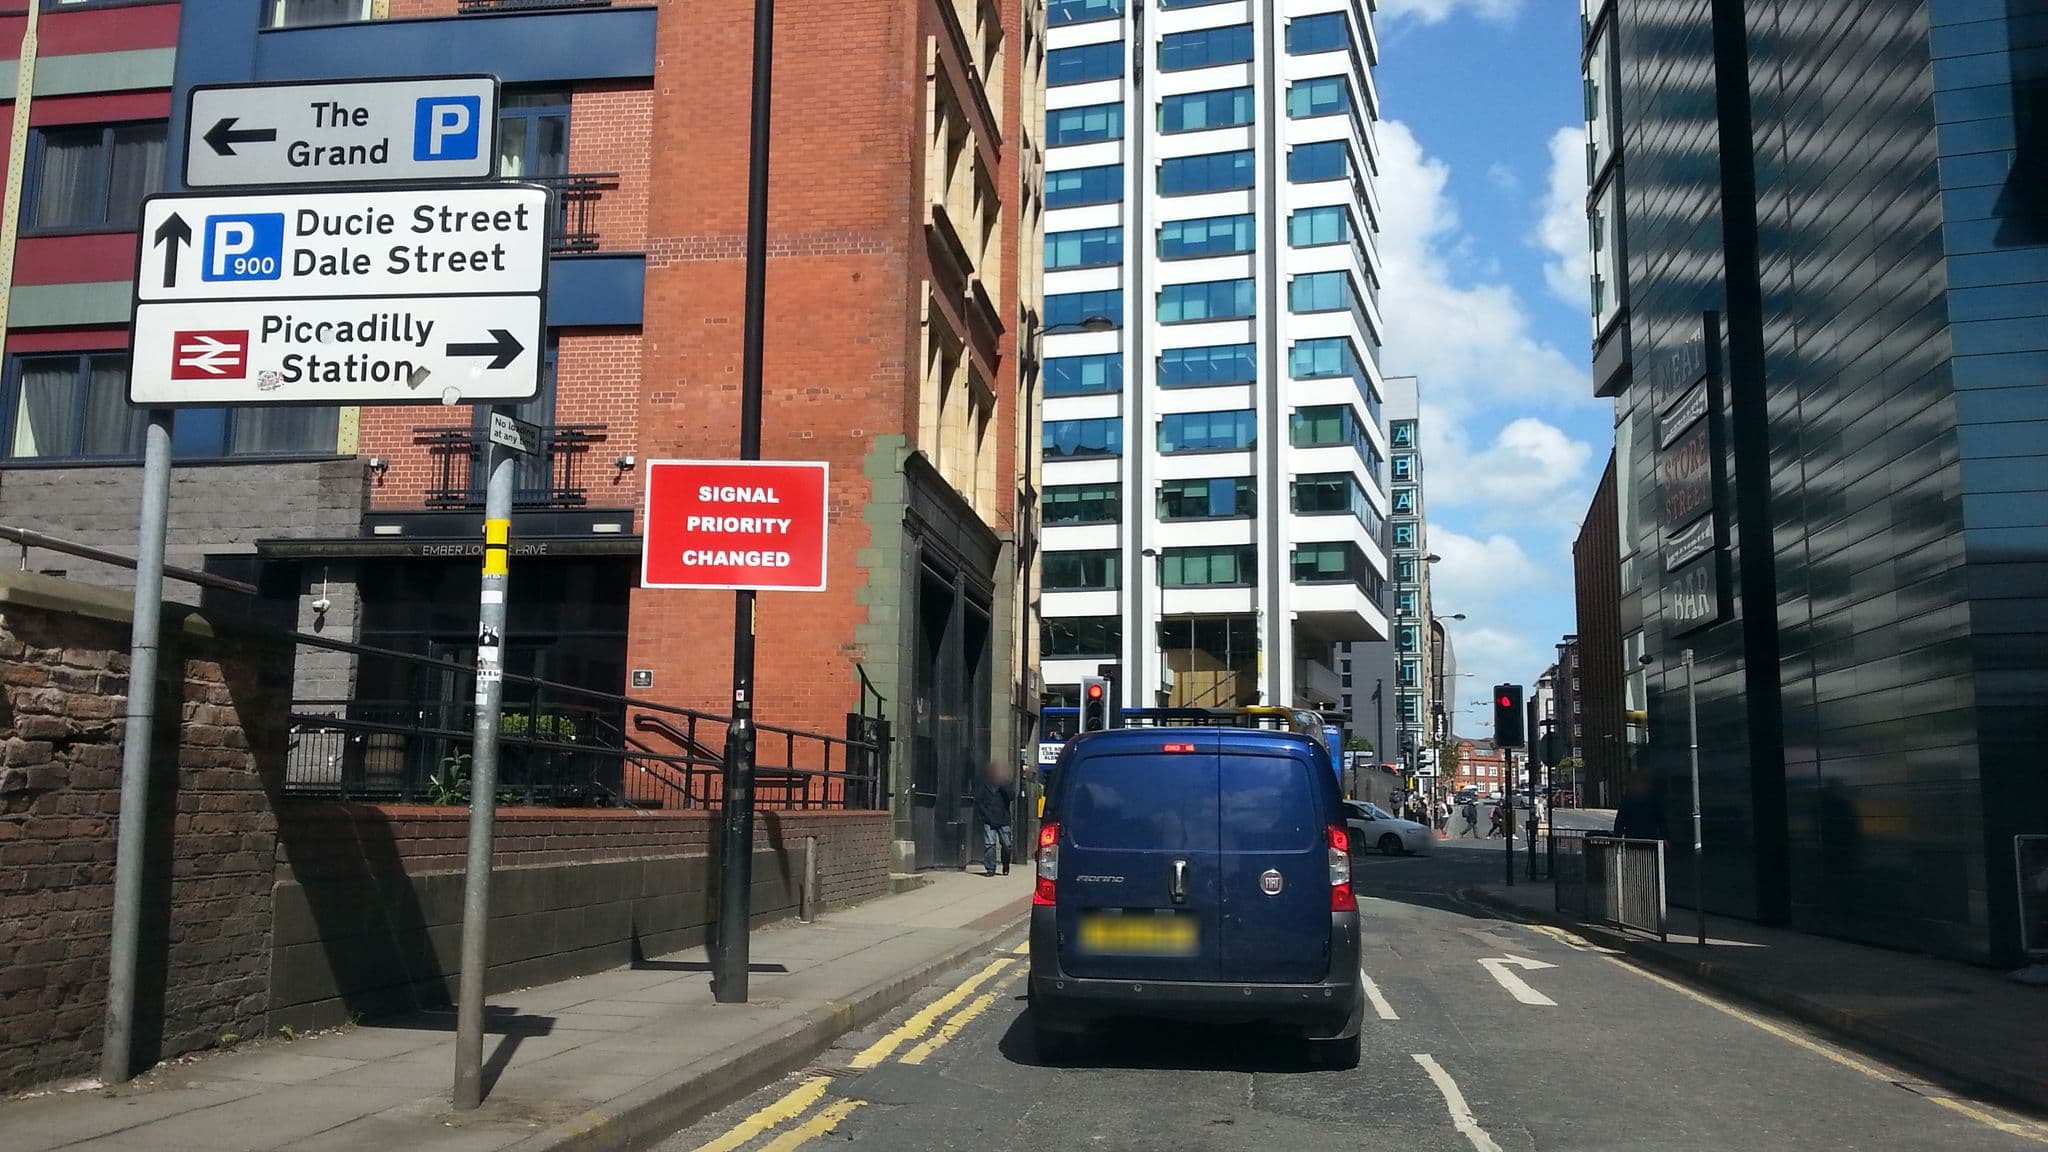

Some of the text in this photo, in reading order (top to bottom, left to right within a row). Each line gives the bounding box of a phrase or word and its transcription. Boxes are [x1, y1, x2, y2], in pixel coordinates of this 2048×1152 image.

[310, 102, 369, 128] The
[429, 104, 470, 155] P
[287, 137, 389, 168] Grand
[296, 203, 529, 236] Ducie Street
[212, 222, 254, 275] P
[293, 243, 506, 277] Dale Street
[234, 257, 275, 275] 900
[260, 312, 434, 347] Piccadilly
[281, 354, 413, 383] Station
[494, 430, 502, 438] at
[504, 433, 518, 444] any
[495, 417, 506, 429] No
[1664, 430, 1709, 490] STORE
[698, 486, 780, 503] SIGNAL
[1665, 470, 1709, 525] STREET
[686, 516, 792, 534] PRIORITY
[422, 544, 463, 556] EMBER
[682, 550, 791, 567] CHANGED
[1673, 566, 1712, 620] BAR
[1265, 877, 1280, 889] FIAT
